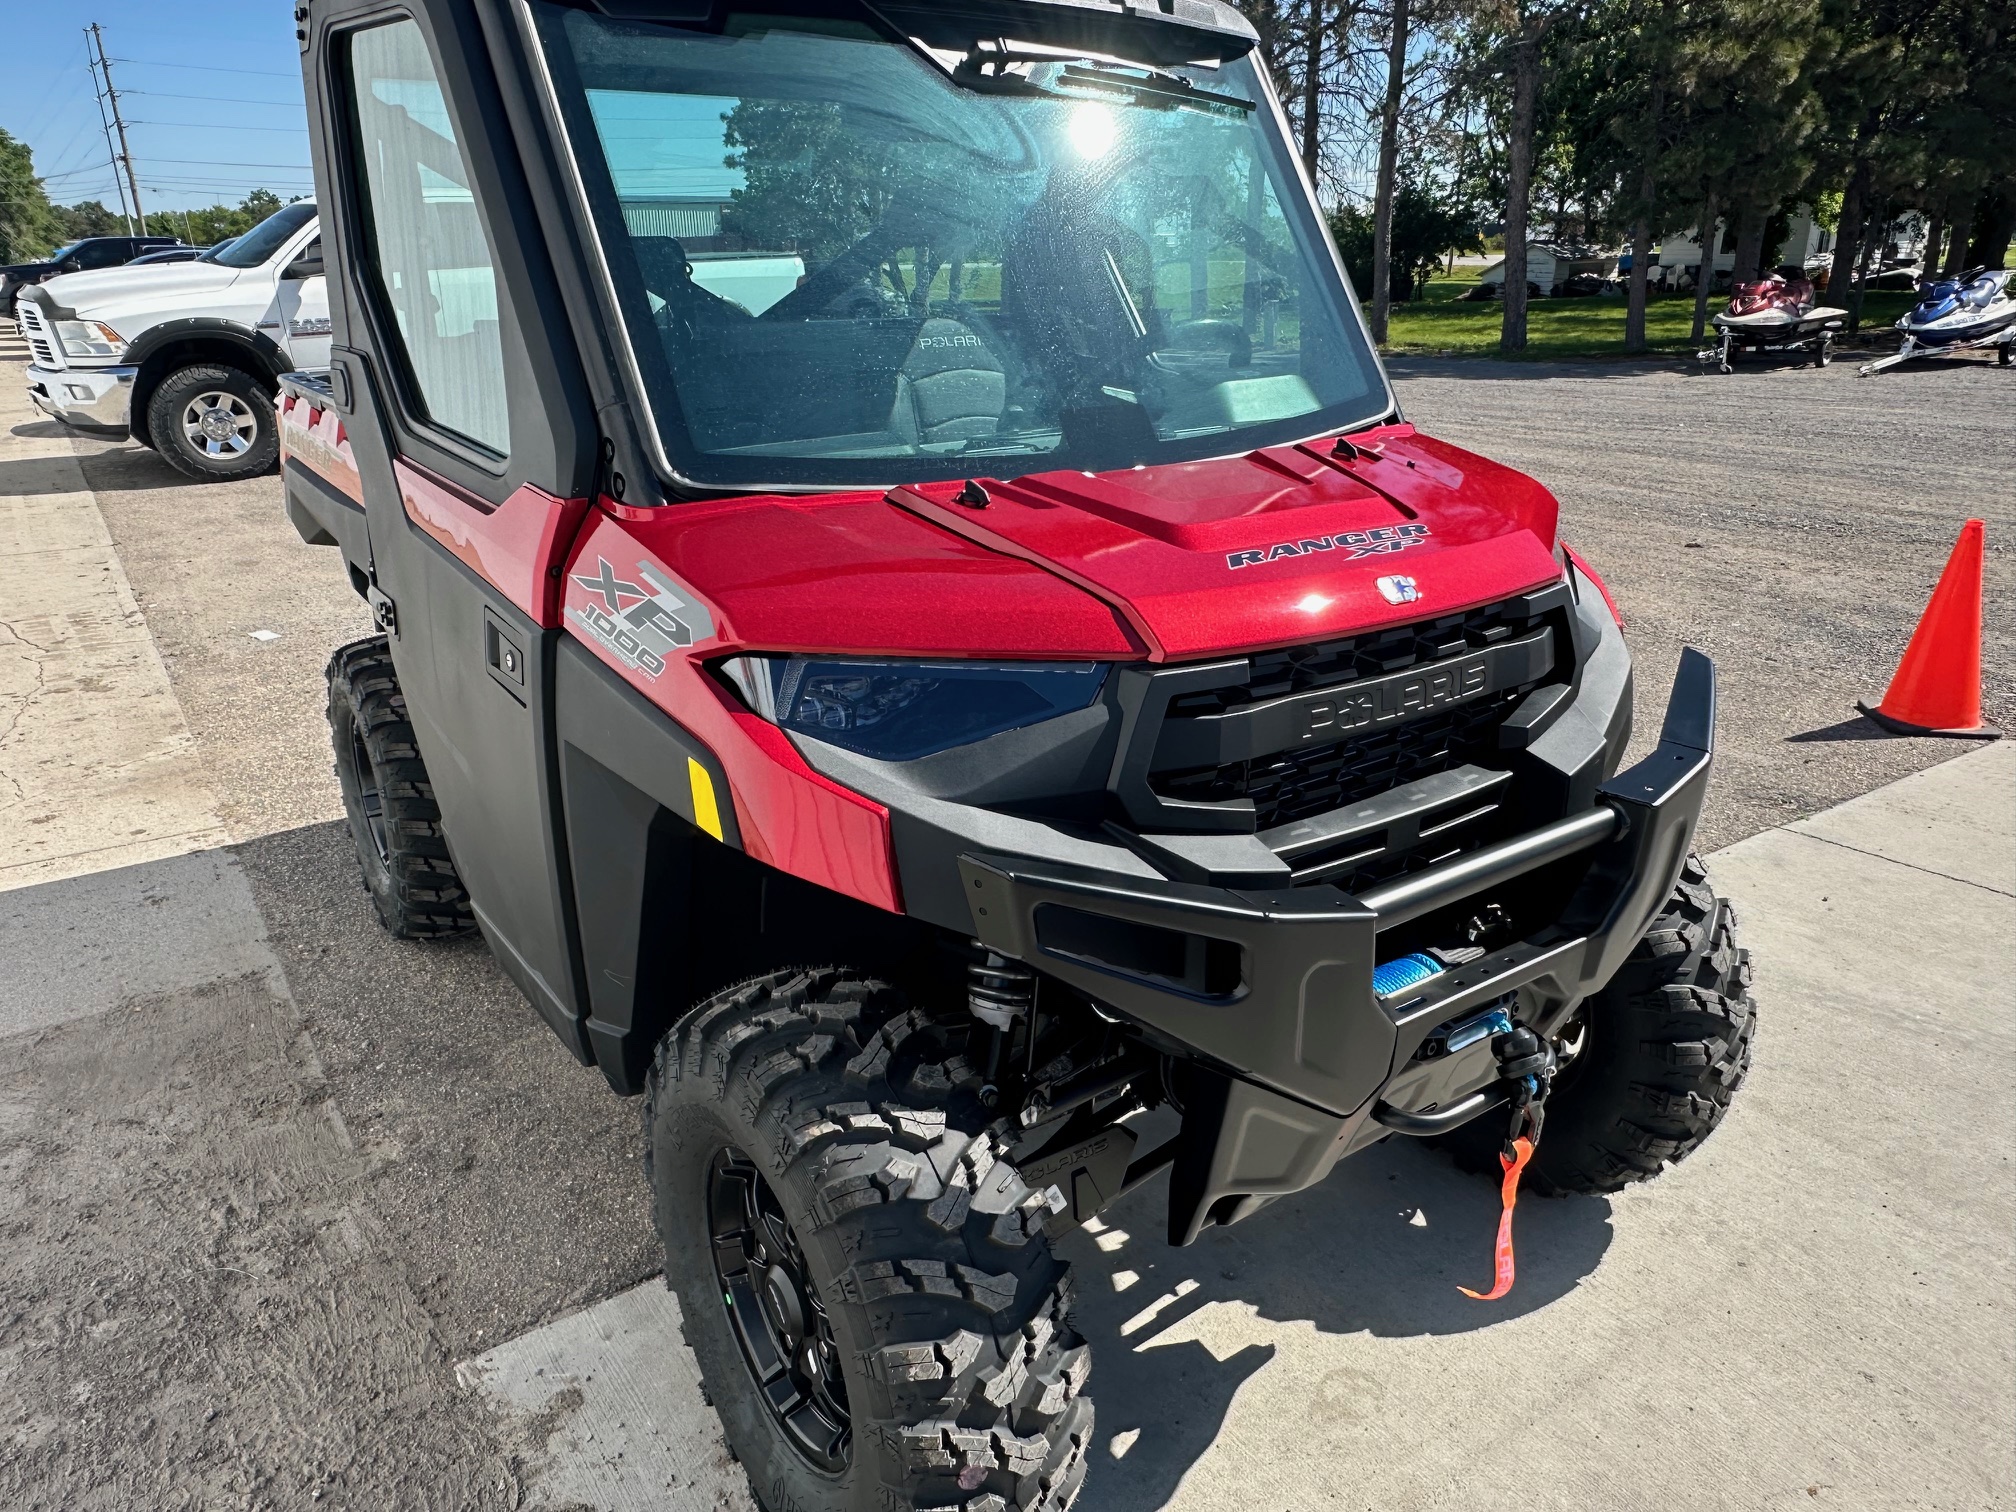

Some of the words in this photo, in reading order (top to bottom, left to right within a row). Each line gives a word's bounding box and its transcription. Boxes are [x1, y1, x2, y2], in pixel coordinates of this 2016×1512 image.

[919, 335, 982, 349] POLARI
[1226, 524, 1432, 569] RANGER
[1343, 537, 1426, 562] XP
[570, 554, 693, 647] XP
[577, 602, 667, 677] 1000
[1303, 660, 1487, 739] POLARIS
